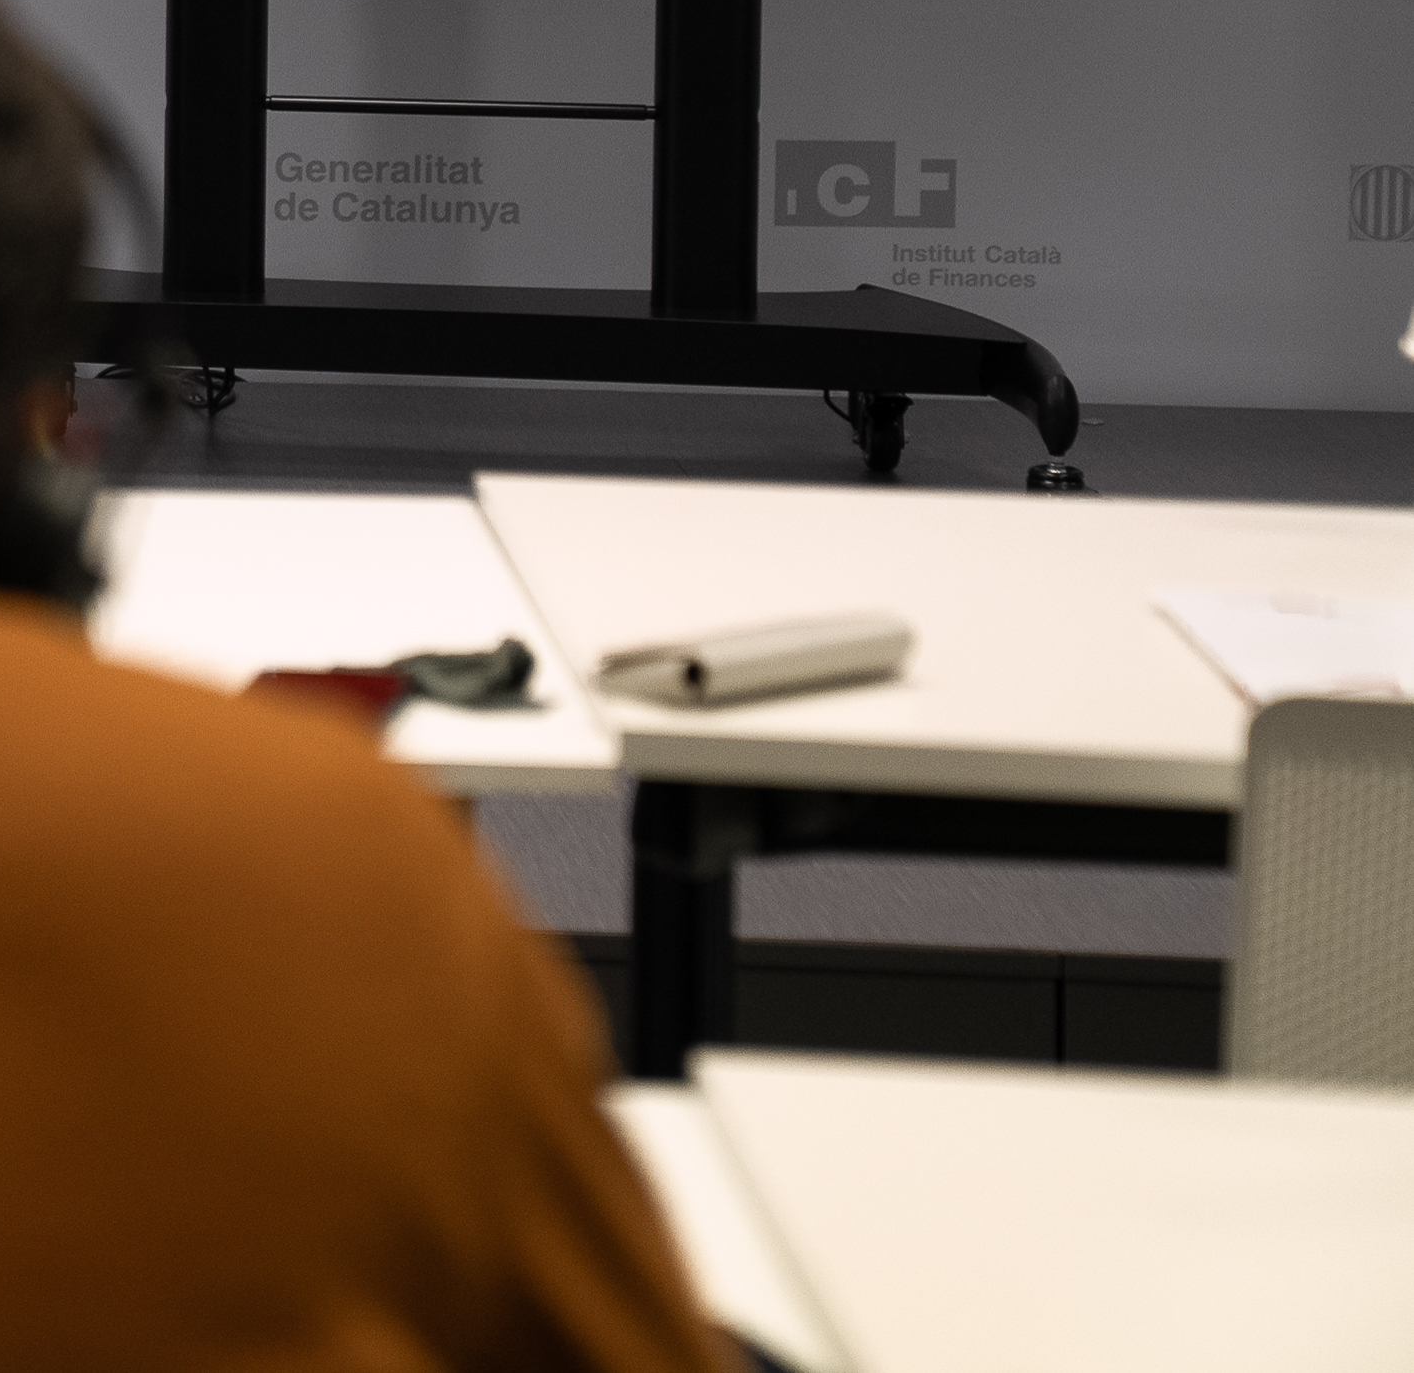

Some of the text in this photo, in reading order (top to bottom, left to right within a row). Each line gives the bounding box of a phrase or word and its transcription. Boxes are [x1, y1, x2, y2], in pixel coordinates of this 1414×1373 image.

[275, 152, 483, 186] Generalitat
[273, 191, 520, 232] de Catalunya
[892, 243, 1062, 265] Institut Català
[891, 267, 1037, 289] de Finances
